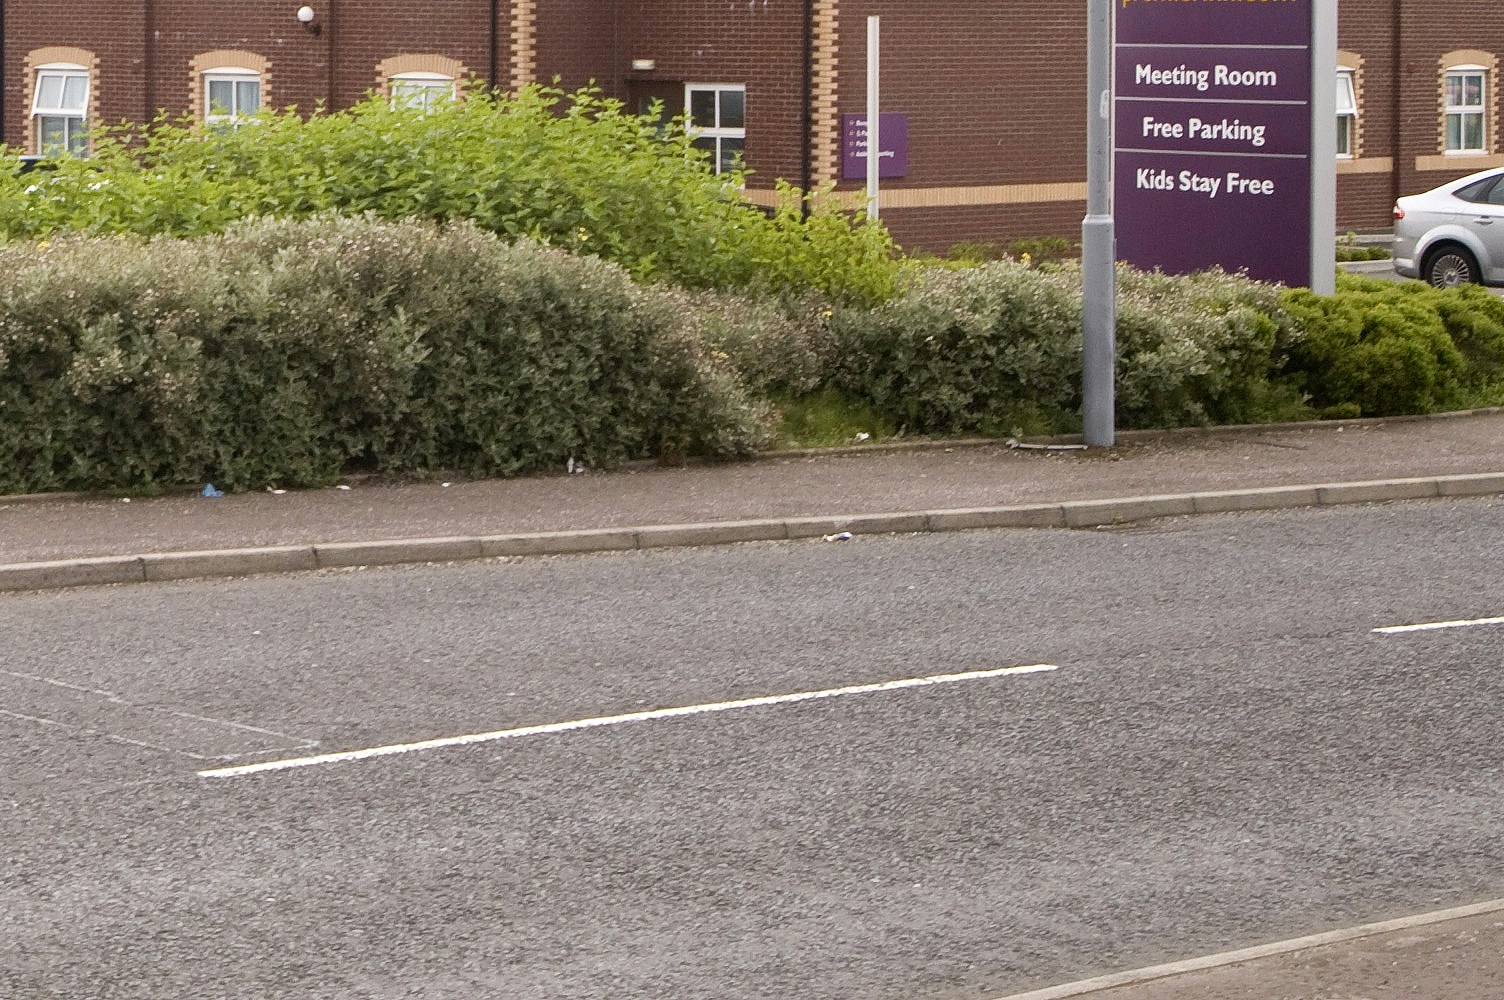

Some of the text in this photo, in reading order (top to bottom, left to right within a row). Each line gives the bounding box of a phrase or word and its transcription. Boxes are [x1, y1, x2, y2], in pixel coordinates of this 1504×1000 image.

[1135, 64, 1277, 91] Meeting Room
[1142, 117, 1266, 147] Free Parking
[1136, 168, 1275, 198] Kids Stay Free
